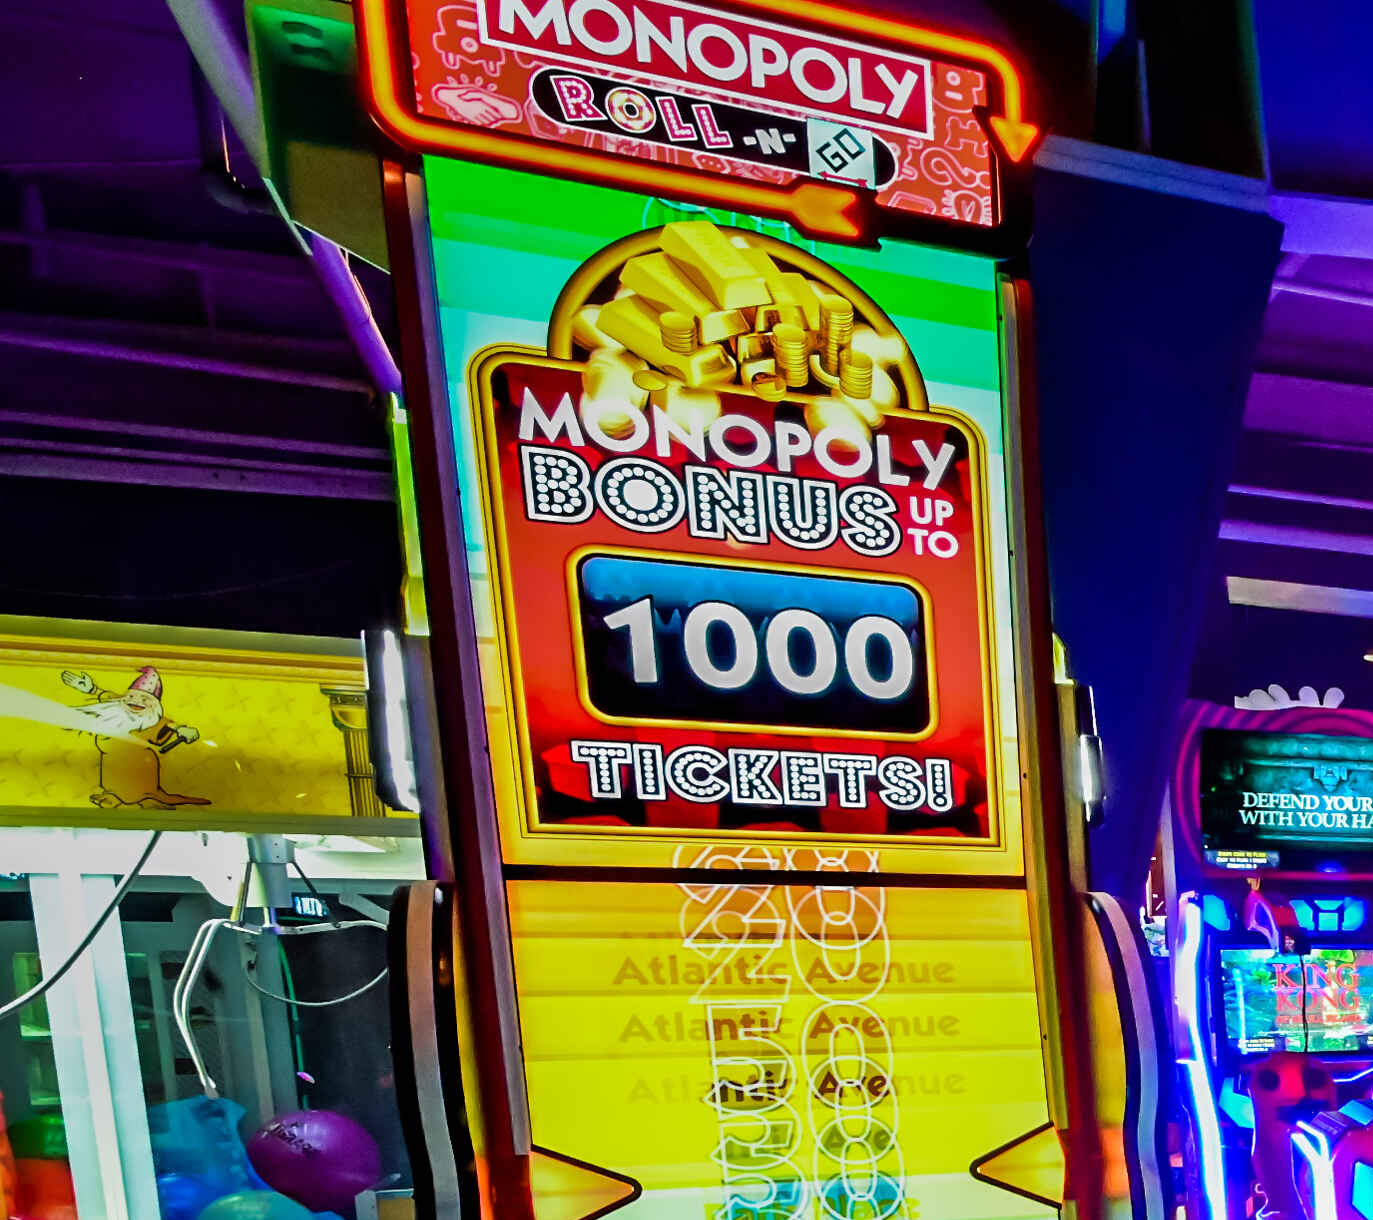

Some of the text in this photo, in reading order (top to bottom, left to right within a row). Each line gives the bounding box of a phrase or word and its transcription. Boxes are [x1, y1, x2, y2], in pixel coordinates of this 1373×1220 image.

[498, 0, 919, 119] MONOPOLY
[551, 75, 734, 151] ROLL
[816, 127, 868, 175] GO
[518, 387, 956, 491] MONOPOLY
[521, 446, 899, 557] BONUS
[909, 495, 955, 526] UP
[906, 527, 960, 560] TO
[603, 596, 914, 700] 1000
[570, 740, 954, 813] TICKETS!
[1242, 791, 1320, 810] DEFEND
[1239, 809, 1296, 827] WITH
[1298, 811, 1349, 829] YOUR
[1272, 963, 1361, 991] KING
[1275, 988, 1361, 1012] KONG
